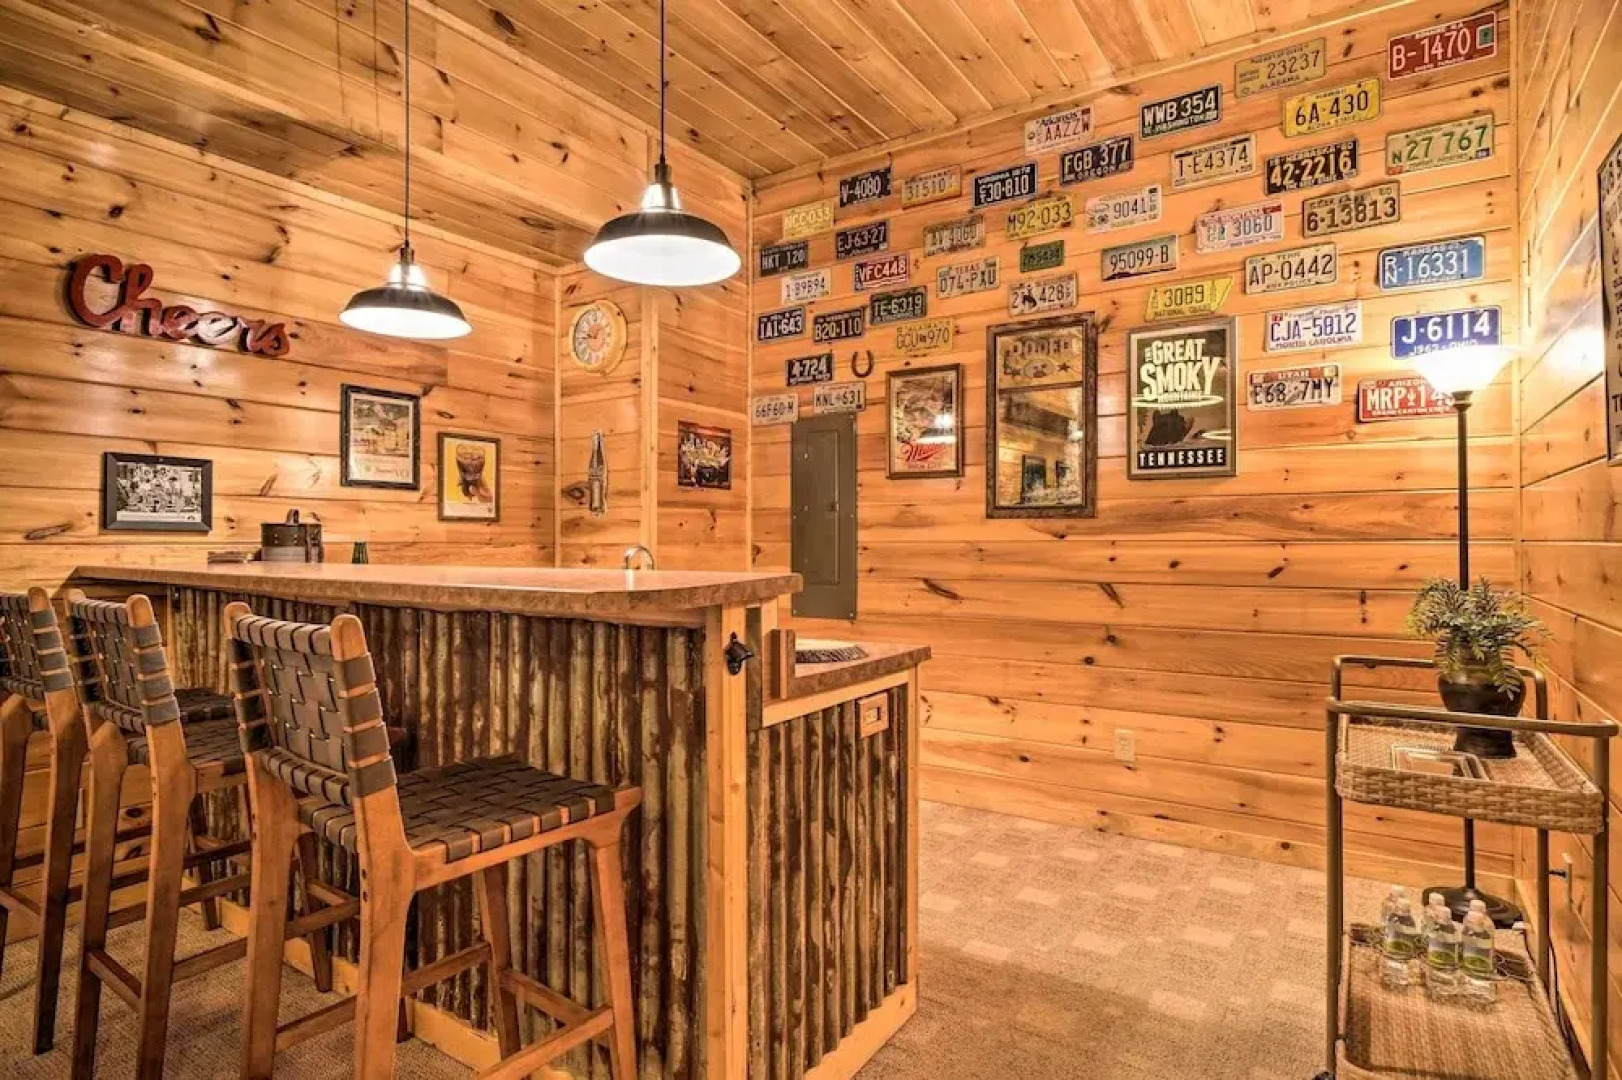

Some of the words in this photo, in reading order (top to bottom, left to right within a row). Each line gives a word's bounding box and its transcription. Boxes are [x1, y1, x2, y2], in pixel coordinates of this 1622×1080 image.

[1267, 48, 1320, 79] 23237
[1392, 26, 1471, 71] B-1470
[1100, 139, 1130, 166] 377
[63, 254, 291, 358] Cheers
[1270, 312, 1357, 342] CJA-5812
[1151, 338, 1206, 365] GREAT
[1140, 356, 1221, 401] SMOKY
[1366, 386, 1407, 412] MRP
[1138, 448, 1224, 468] TENNESSEE
